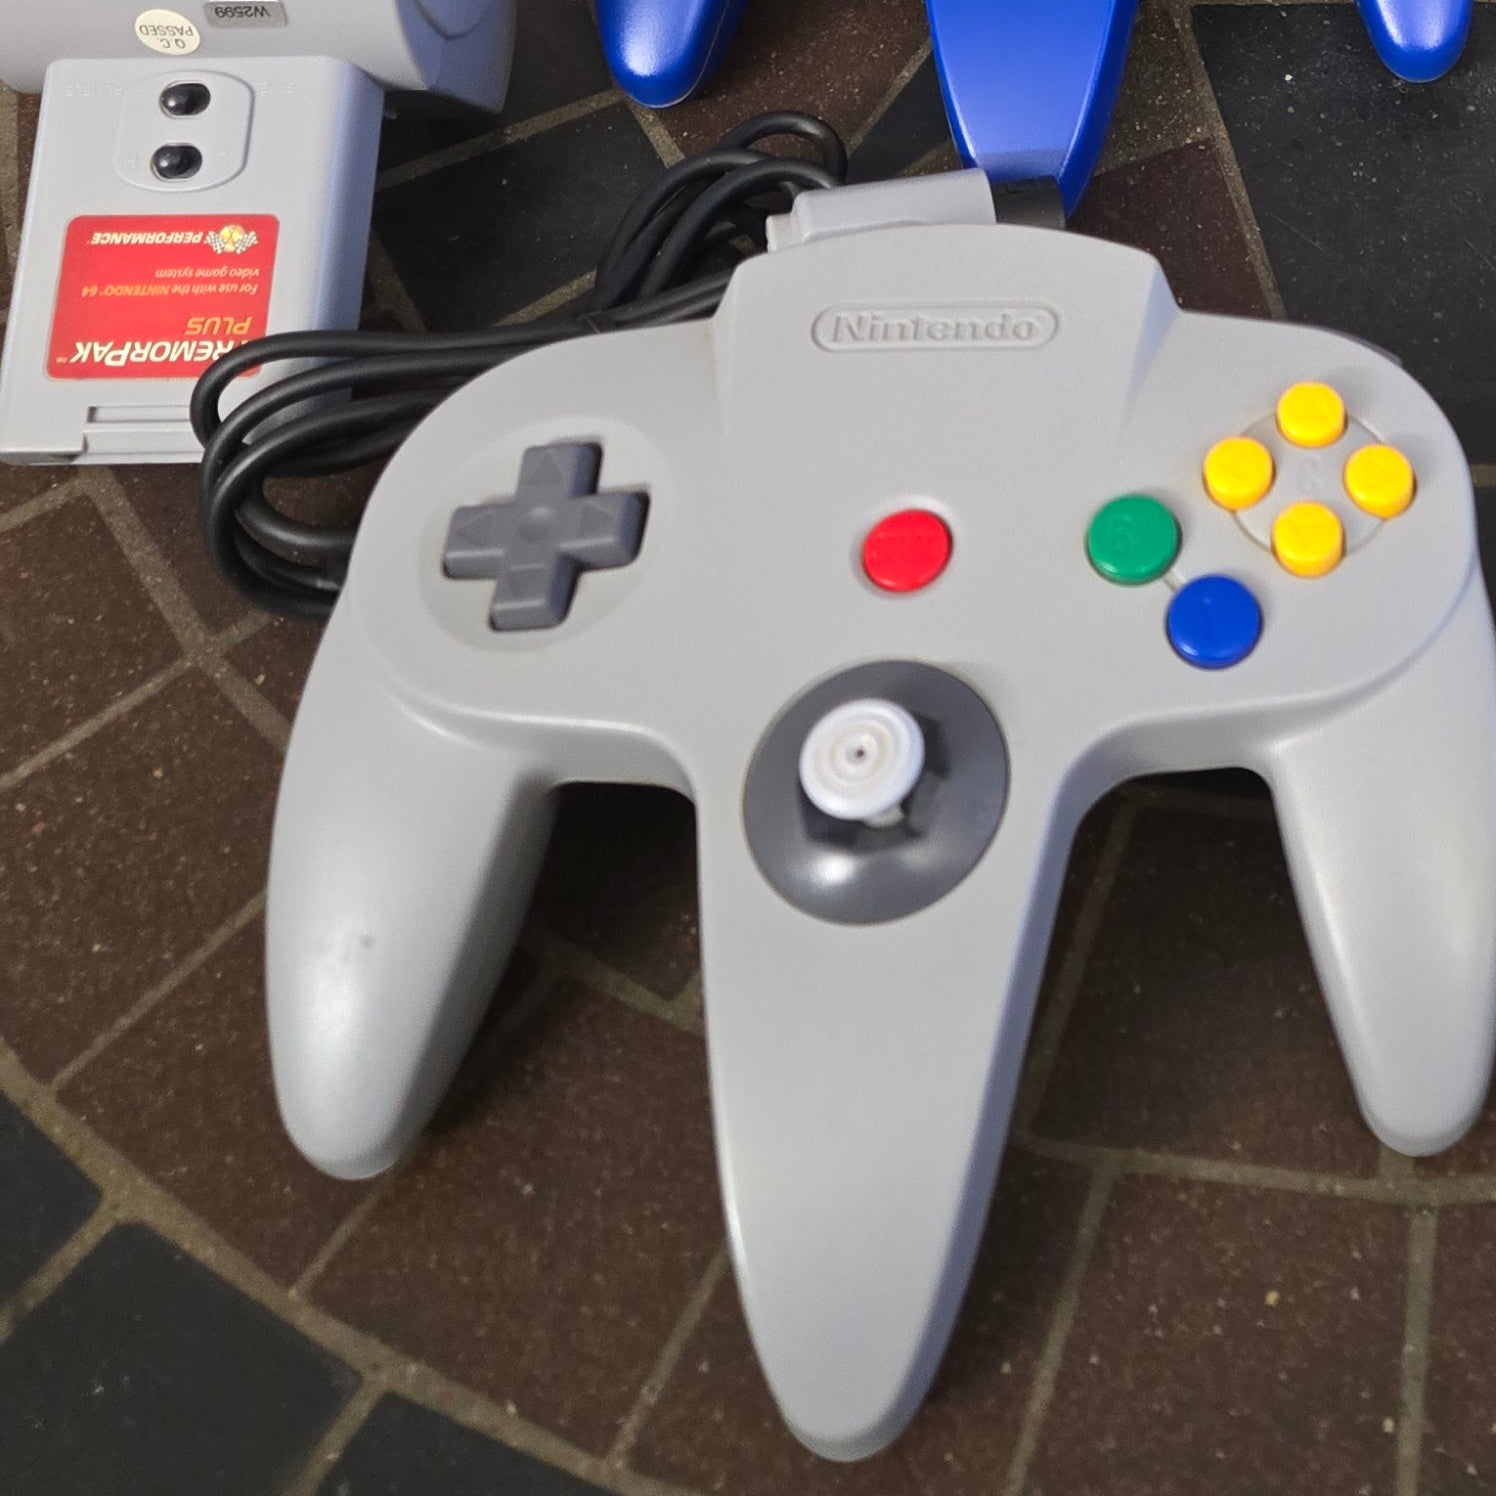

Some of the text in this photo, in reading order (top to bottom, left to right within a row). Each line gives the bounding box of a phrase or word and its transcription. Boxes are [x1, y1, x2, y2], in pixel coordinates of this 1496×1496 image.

[215, 5, 269, 18] W2599
[139, 24, 193, 37] PASSED
[90, 232, 202, 245] PERFORMANCE
[155, 267, 259, 278] video game system
[82, 286, 98, 297] 64
[171, 284, 191, 295] the
[192, 284, 217, 295] with
[219, 285, 239, 294] use
[241, 284, 258, 296] For
[185, 316, 252, 336] PLUS
[832, 310, 1035, 343] Nintendo
[69, 341, 248, 367] REMORPAK
